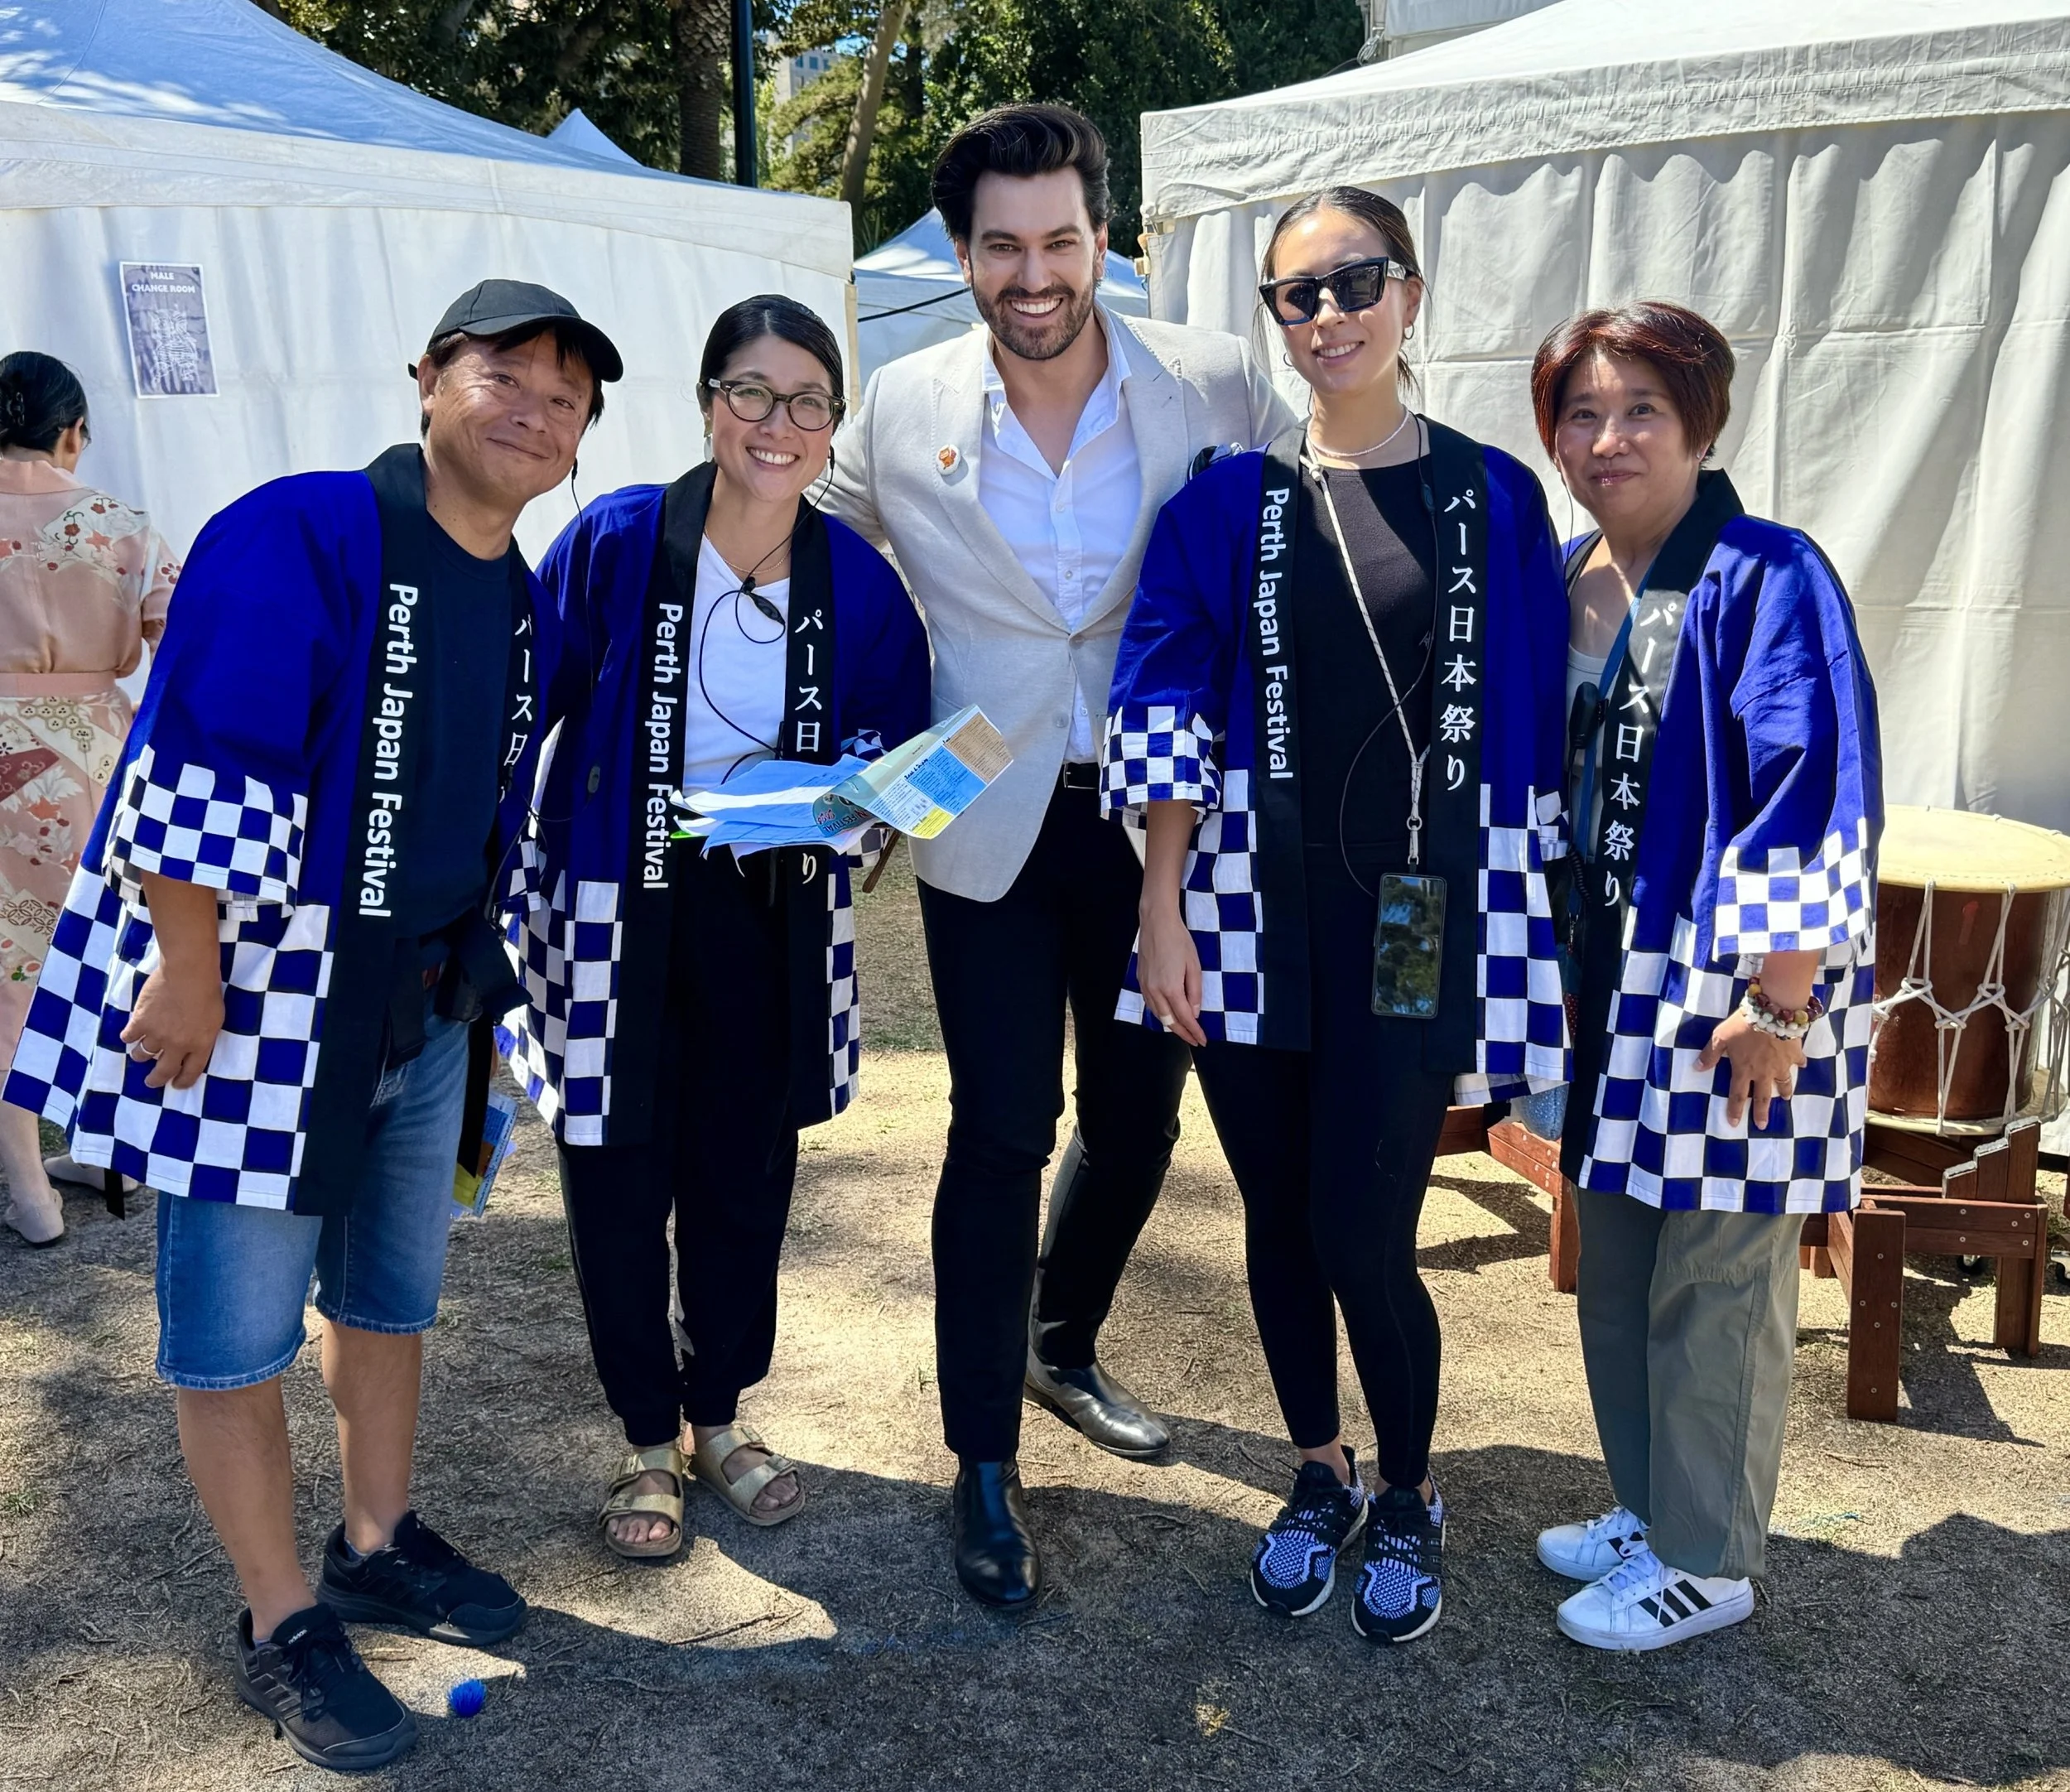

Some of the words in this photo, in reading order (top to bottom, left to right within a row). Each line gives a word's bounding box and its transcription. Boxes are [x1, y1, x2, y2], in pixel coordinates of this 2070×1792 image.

[132, 283, 169, 292] CHANGE
[170, 285, 195, 293] ROOM
[151, 272, 174, 280] MALE
[1260, 488, 1290, 561] Perth
[385, 583, 418, 674] Perth
[653, 603, 683, 683] Perth
[1253, 570, 1283, 656] Japan
[1439, 489, 1477, 791] パース日本祭り
[372, 682, 413, 780] Japan
[644, 691, 678, 773] Japan
[1265, 665, 1293, 778] Festival
[1604, 602, 1678, 907] パース日本祭り
[359, 792, 402, 918] Festival
[643, 783, 674, 889] Festival
[823, 815, 858, 832] FESTIVAL
